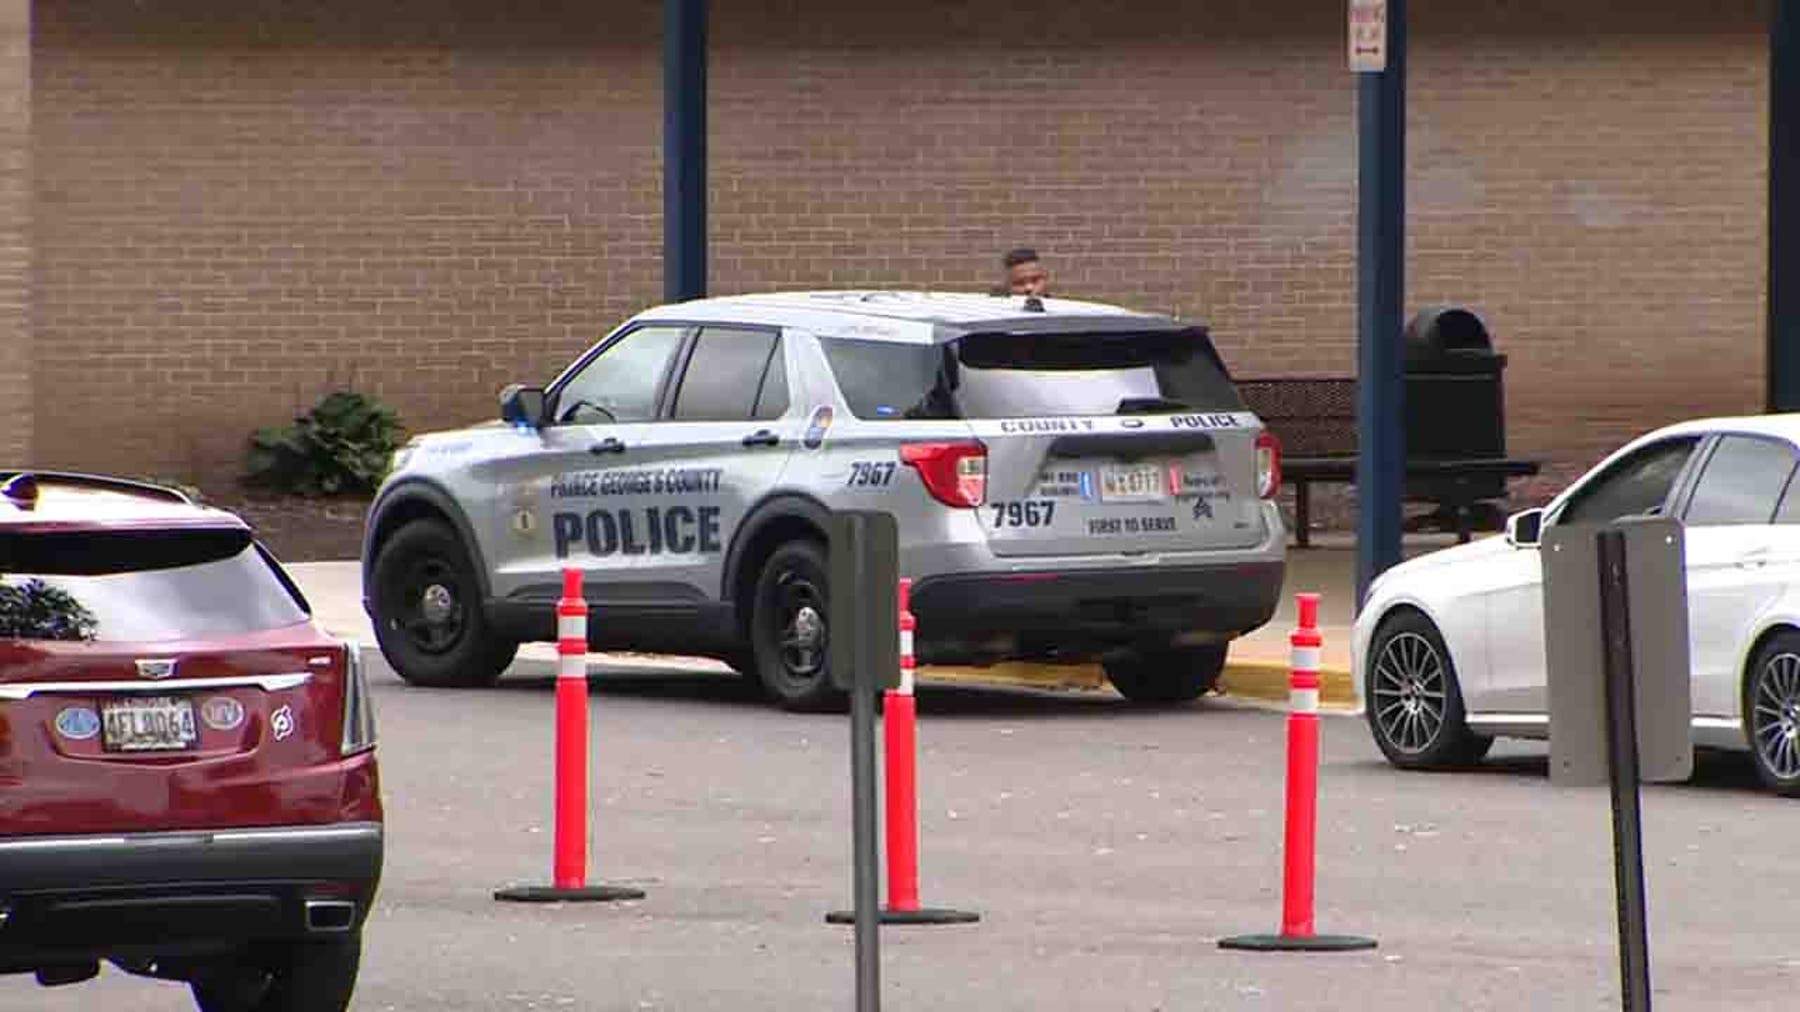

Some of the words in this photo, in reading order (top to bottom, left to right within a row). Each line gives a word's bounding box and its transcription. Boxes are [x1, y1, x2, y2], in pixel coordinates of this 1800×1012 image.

[1000, 419, 1095, 434] COUNTY
[1170, 414, 1240, 428] POLICE
[847, 461, 895, 487] 7967
[990, 500, 1055, 527] 7967
[552, 505, 722, 557] POLICE
